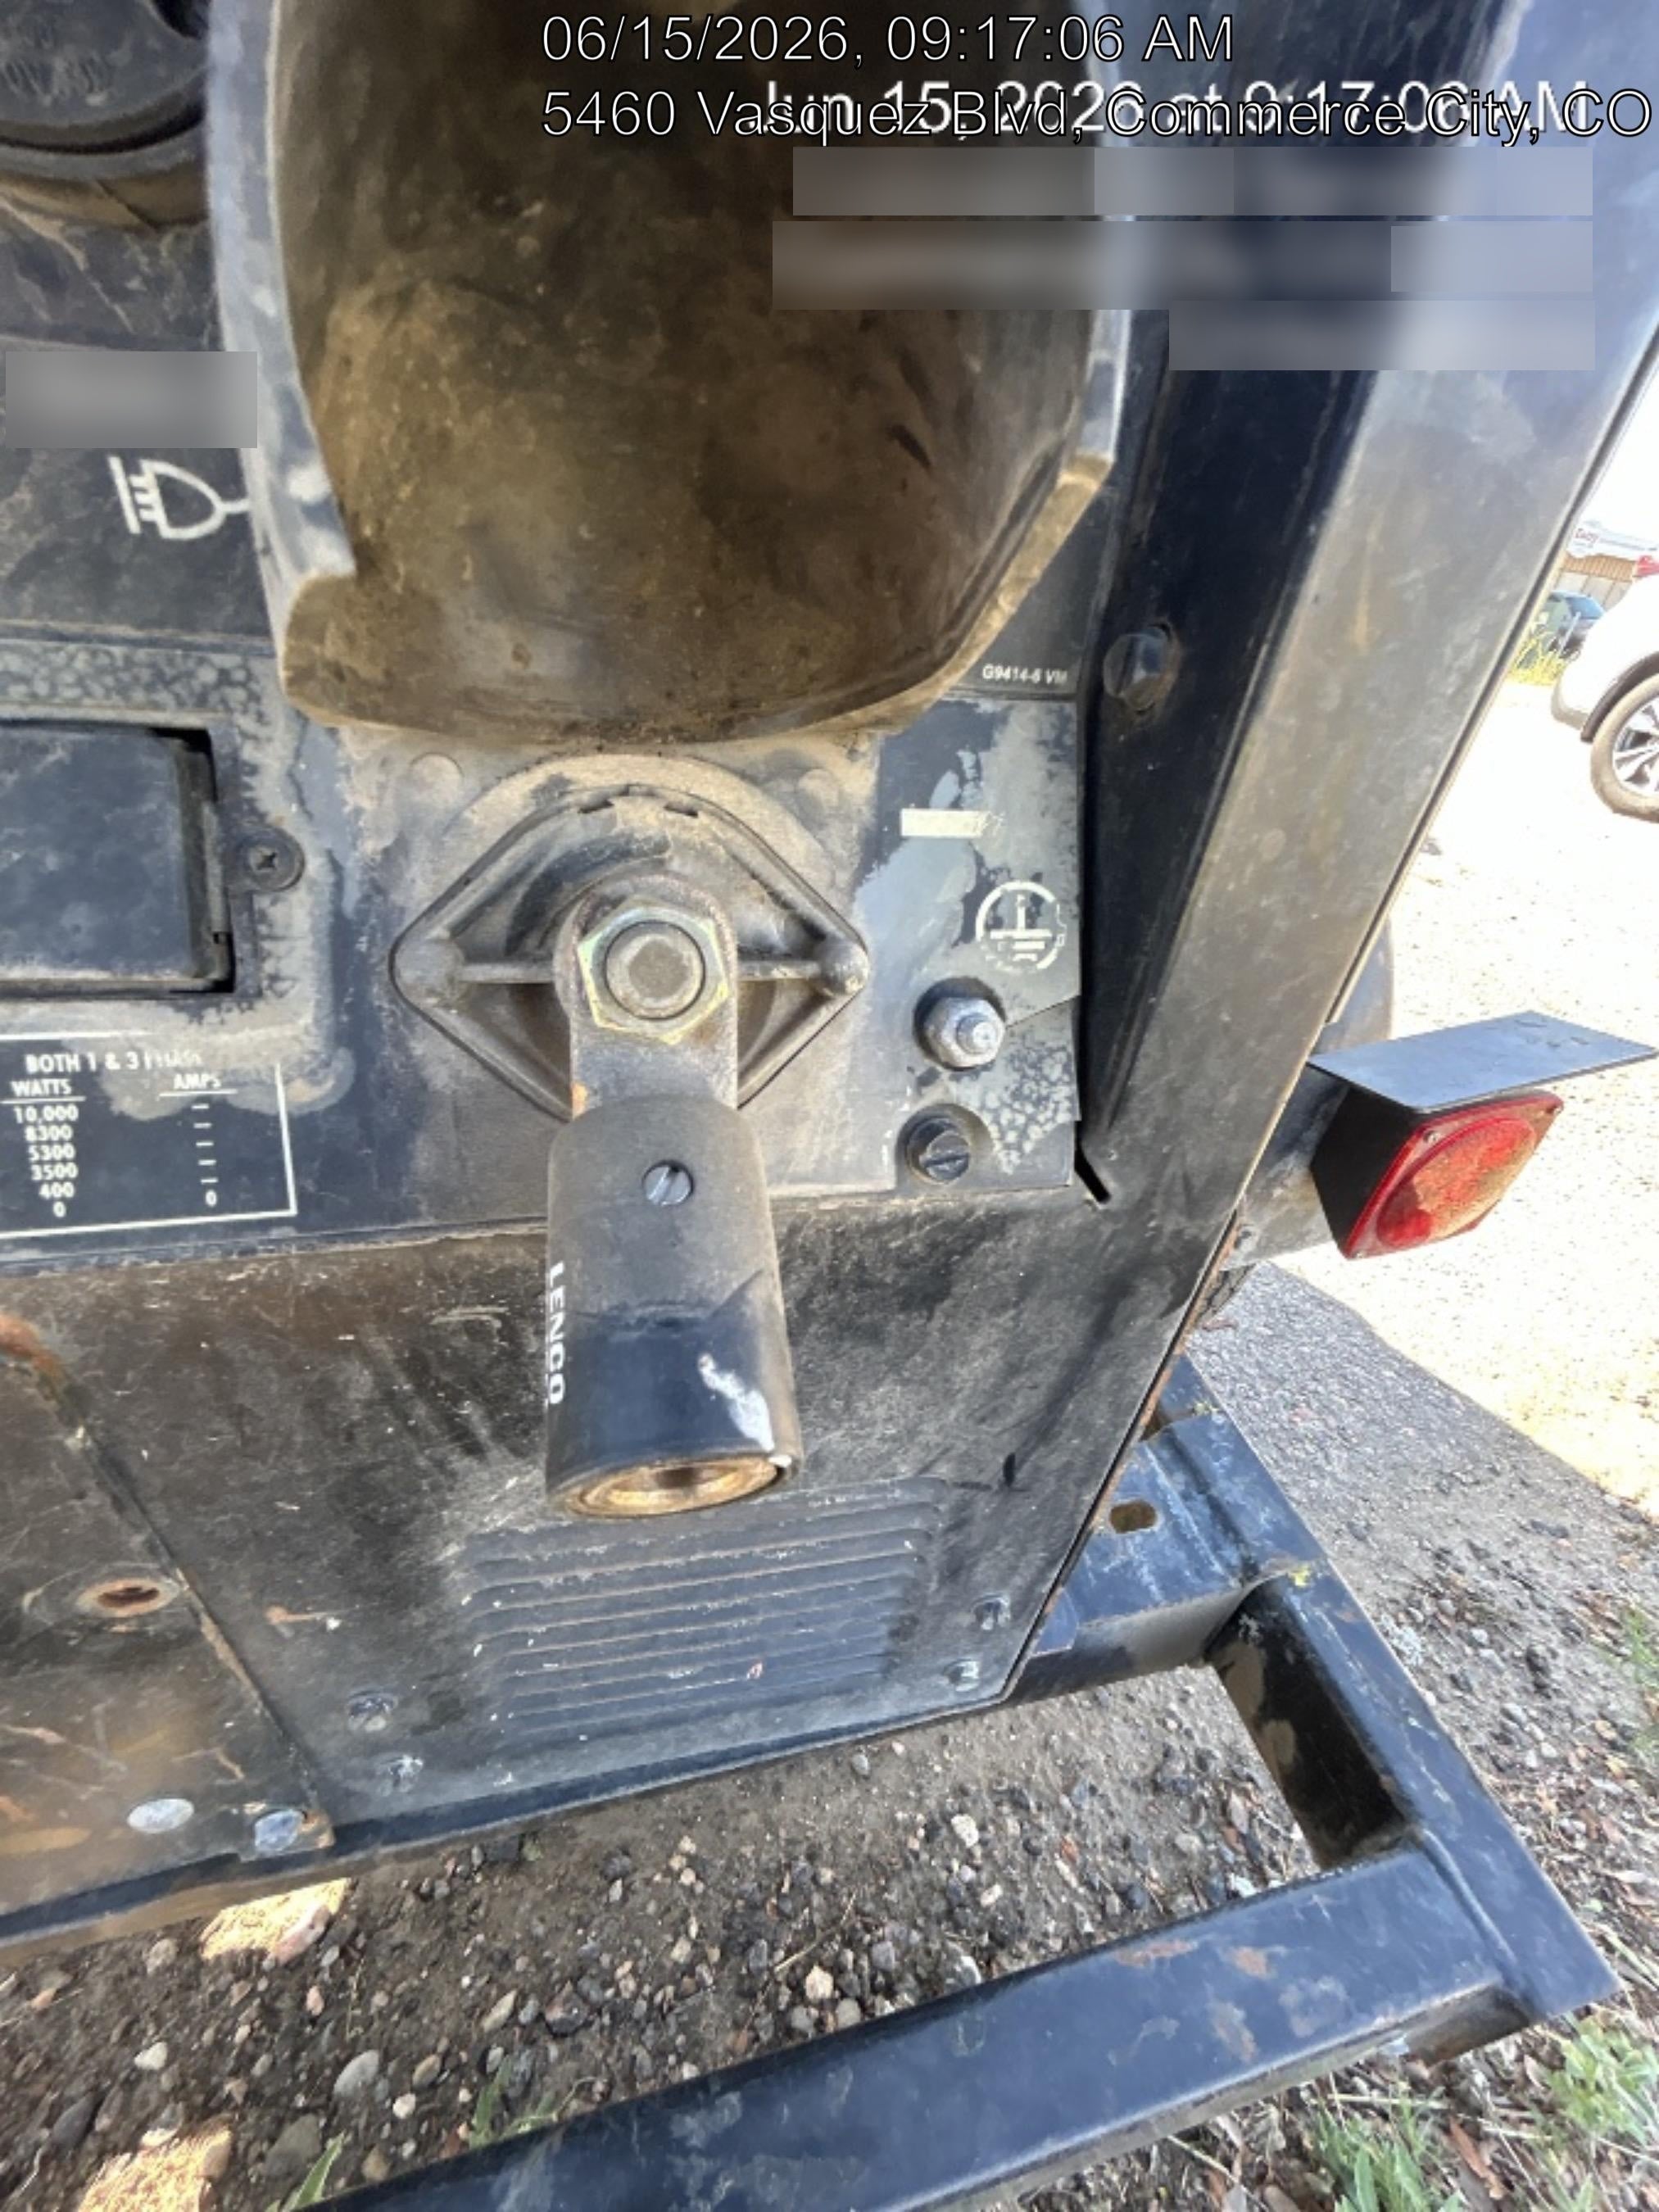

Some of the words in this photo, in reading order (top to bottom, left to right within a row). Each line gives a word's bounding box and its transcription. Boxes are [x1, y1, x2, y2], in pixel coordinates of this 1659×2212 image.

[25, 1053, 81, 1073] BOTH
[85, 1052, 97, 1072] 1
[105, 1052, 121, 1071] &
[126, 1051, 138, 1070] 3
[11, 1078, 72, 1097] WATTS
[174, 1073, 222, 1090] AMPS
[13, 1104, 79, 1124] 10,000
[25, 1124, 74, 1143] 8300
[28, 1145, 76, 1163] 5300
[30, 1163, 79, 1181] 3500
[39, 1181, 75, 1199] 400
[52, 1201, 66, 1217] 0
[549, 1261, 566, 1404] LENCO
